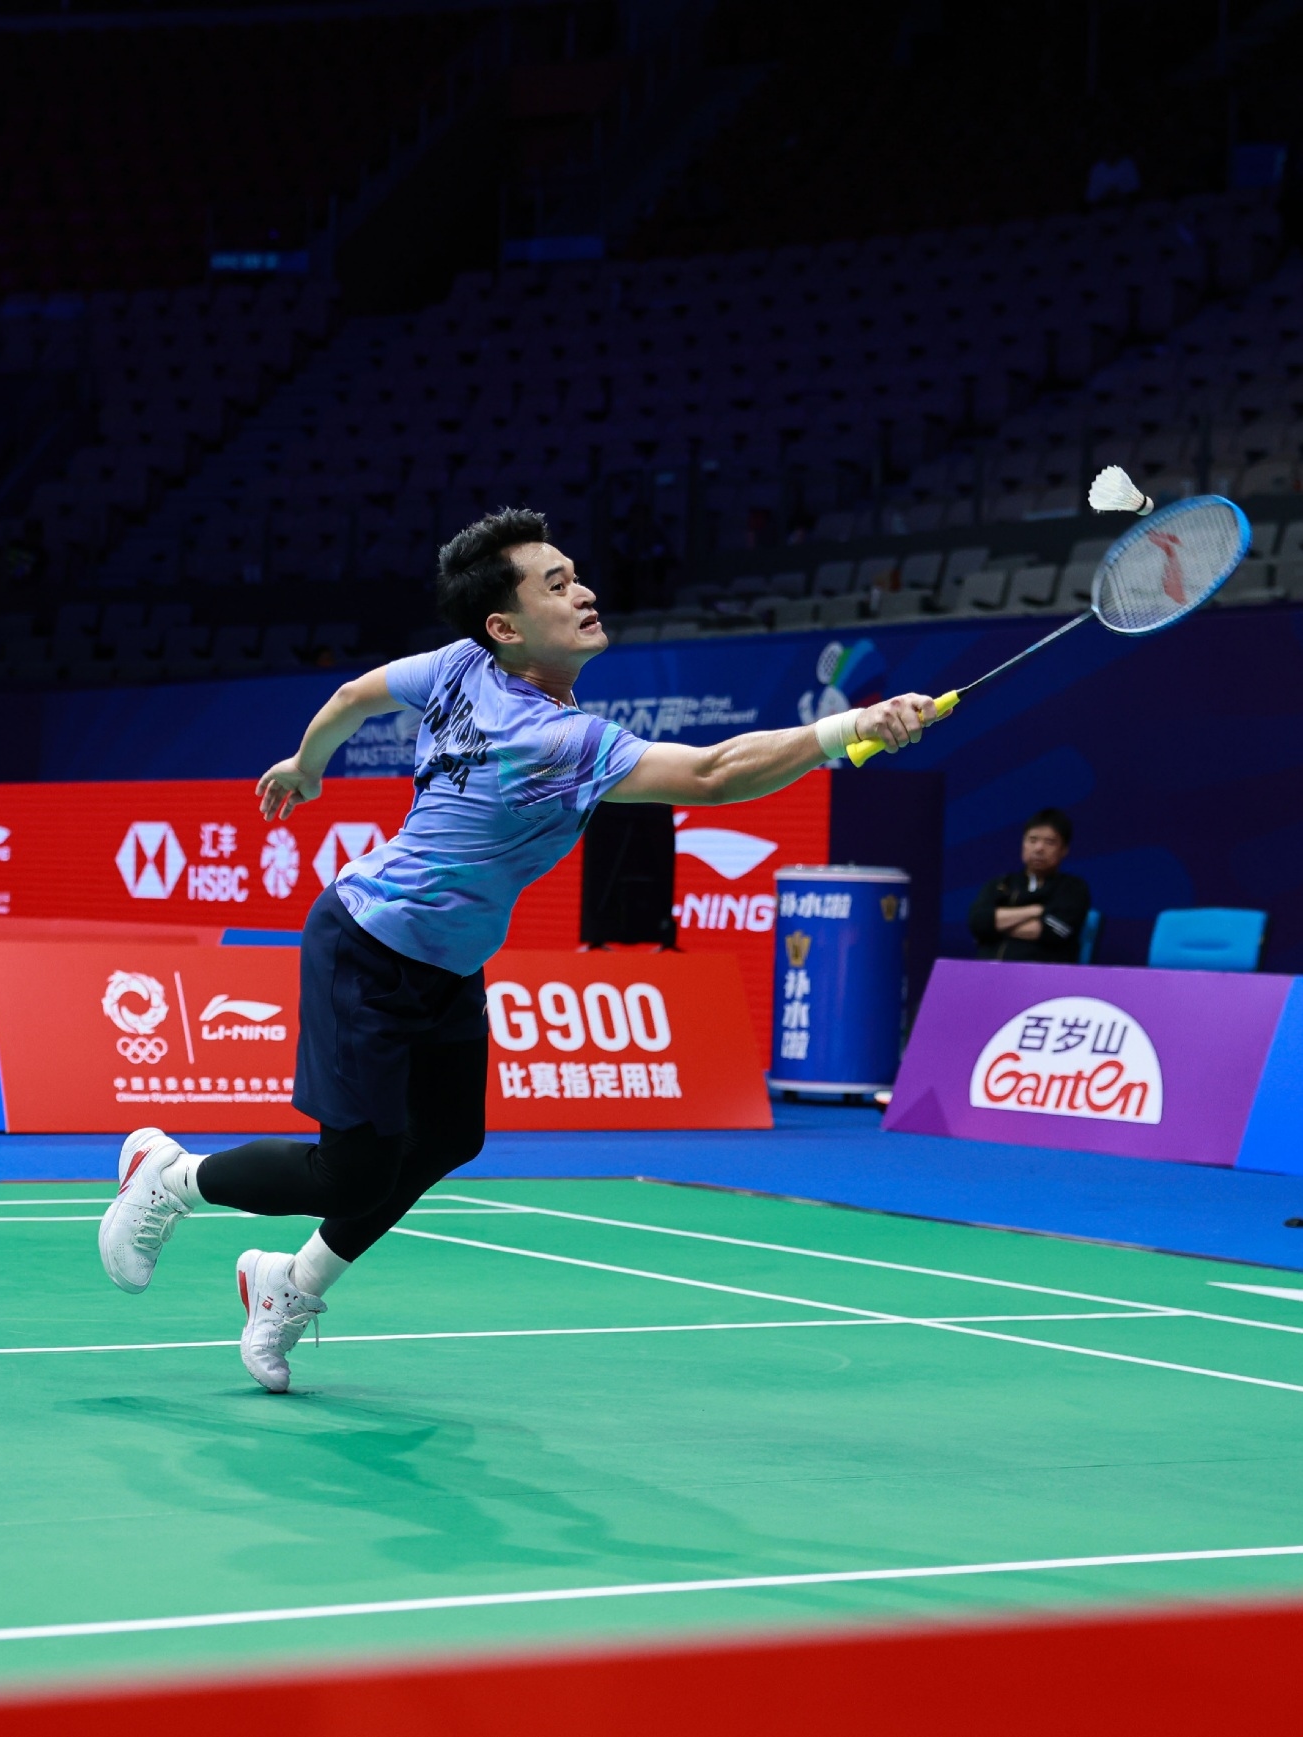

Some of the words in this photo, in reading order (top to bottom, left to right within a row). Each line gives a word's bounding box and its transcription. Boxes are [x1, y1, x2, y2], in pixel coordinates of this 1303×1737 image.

[200, 823, 236, 858] 汇丰
[188, 865, 248, 902] HSBC
[671, 893, 776, 932] -NING
[202, 1025, 287, 1040] LI-NING
[1018, 1015, 1129, 1055] 百岁山
[498, 1062, 682, 1098] 比赛指定用球
